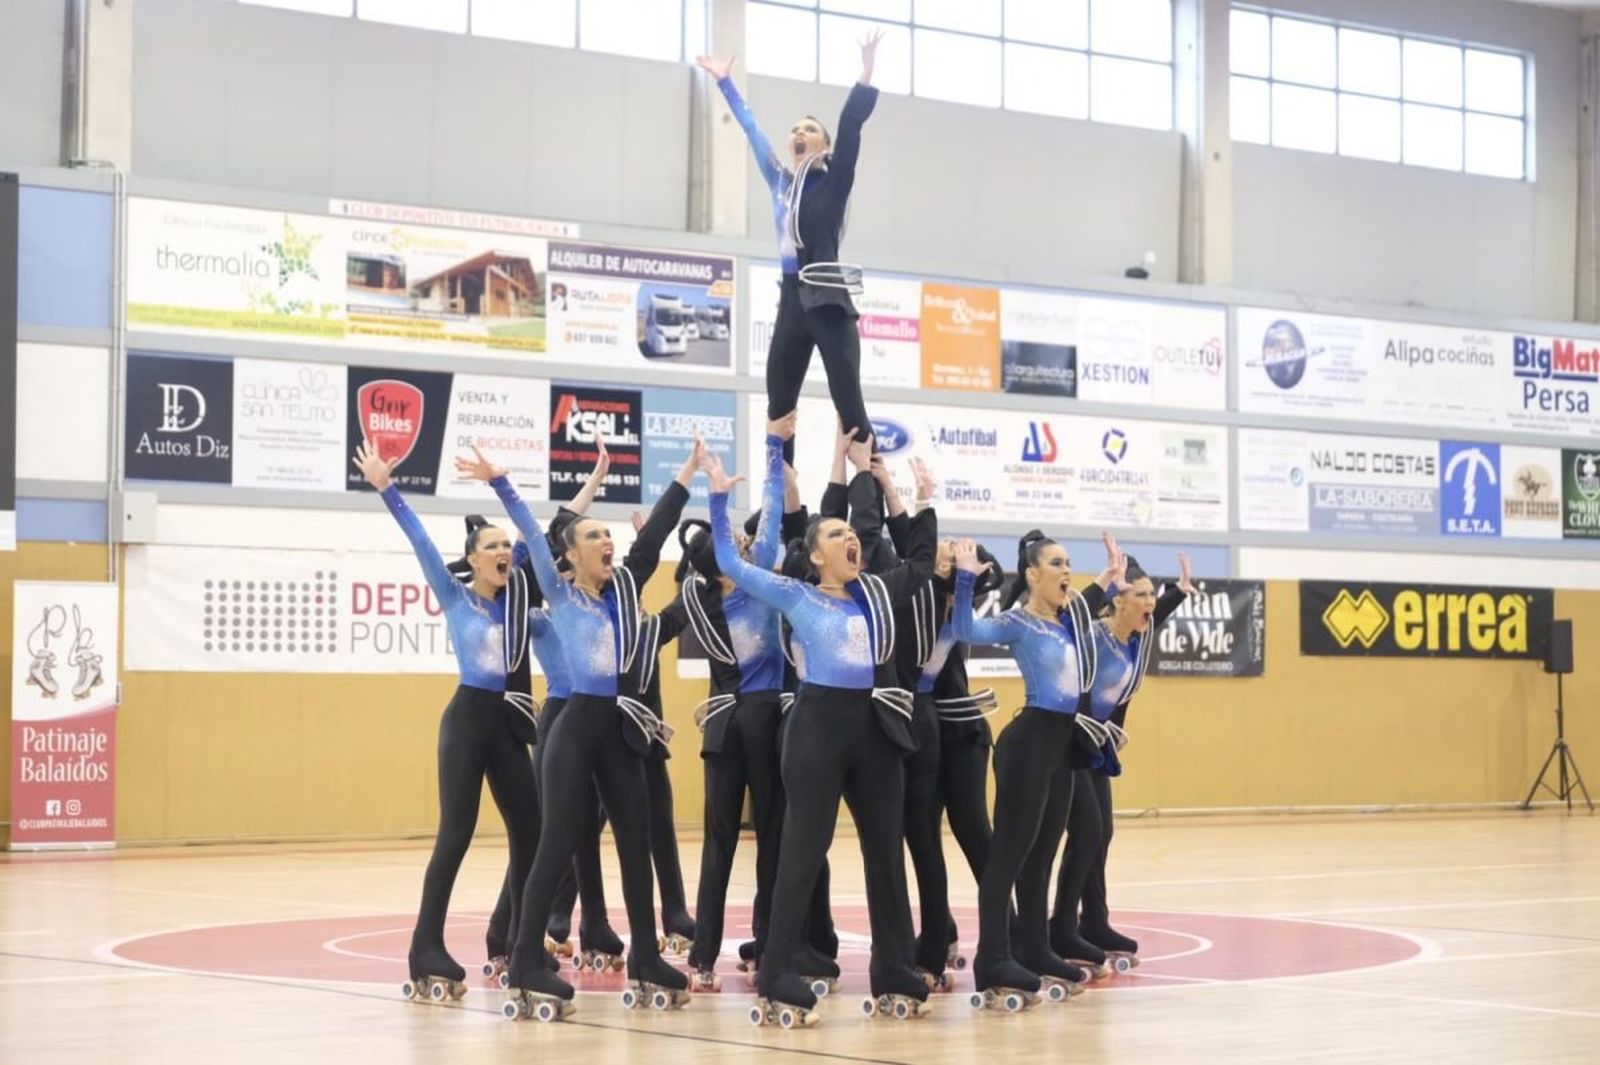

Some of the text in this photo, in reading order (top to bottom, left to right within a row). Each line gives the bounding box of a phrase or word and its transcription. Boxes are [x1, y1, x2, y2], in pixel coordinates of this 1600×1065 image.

[352, 227, 387, 244] circe
[156, 244, 270, 278] thermalia
[550, 250, 604, 269] ALQUILER
[605, 256, 620, 271] DE
[622, 260, 713, 280] AUTOCARAVANAS
[1384, 338, 1435, 368] Alipa
[1513, 335, 1600, 379] BigMat
[1081, 362, 1150, 385] XESTION
[458, 391, 509, 406] VENTA Y
[1523, 380, 1590, 413] Persa
[240, 402, 274, 419] SAN
[457, 412, 535, 430] REPARACIÓN
[369, 413, 413, 433] Bikes
[136, 432, 191, 456] Autos
[196, 434, 230, 459] Diz
[457, 435, 545, 452] DE BICICLETAS
[939, 427, 998, 448] Autofibal
[1310, 450, 1435, 476] NALDO COSTAS
[945, 487, 992, 502] RAMILO
[1447, 518, 1496, 534] S.E.T.A.
[1159, 620, 1188, 653] de
[22, 726, 107, 759] Patinaje
[21, 755, 108, 783] Balaídos
